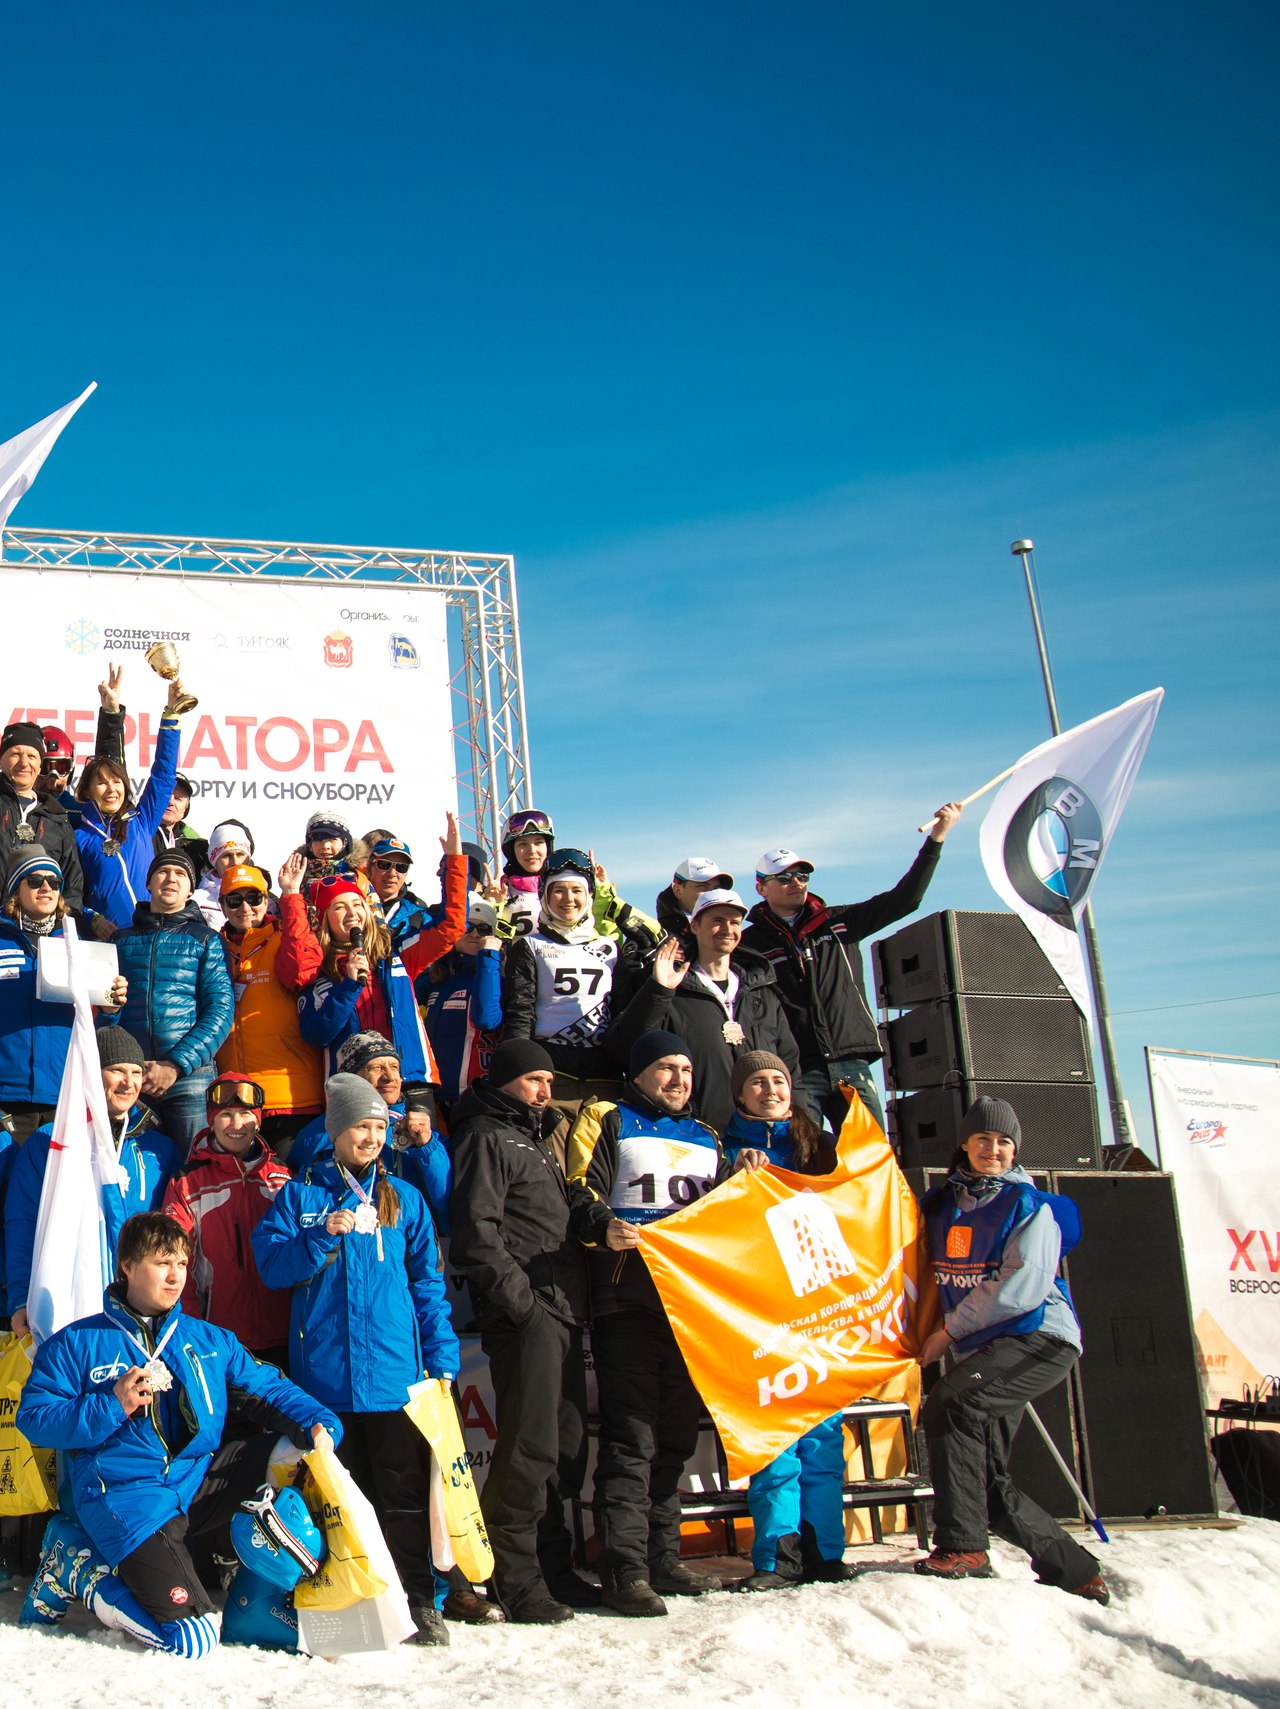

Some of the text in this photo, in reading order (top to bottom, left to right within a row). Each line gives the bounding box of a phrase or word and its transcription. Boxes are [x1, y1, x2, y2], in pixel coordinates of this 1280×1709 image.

[104, 628, 190, 641] солнечная
[242, 781, 257, 799] И
[263, 781, 395, 804] СНОУБОРДУ
[553, 967, 604, 995] 57
[1226, 1228, 1280, 1273] XV
[271, 1607, 298, 1631] LAN
